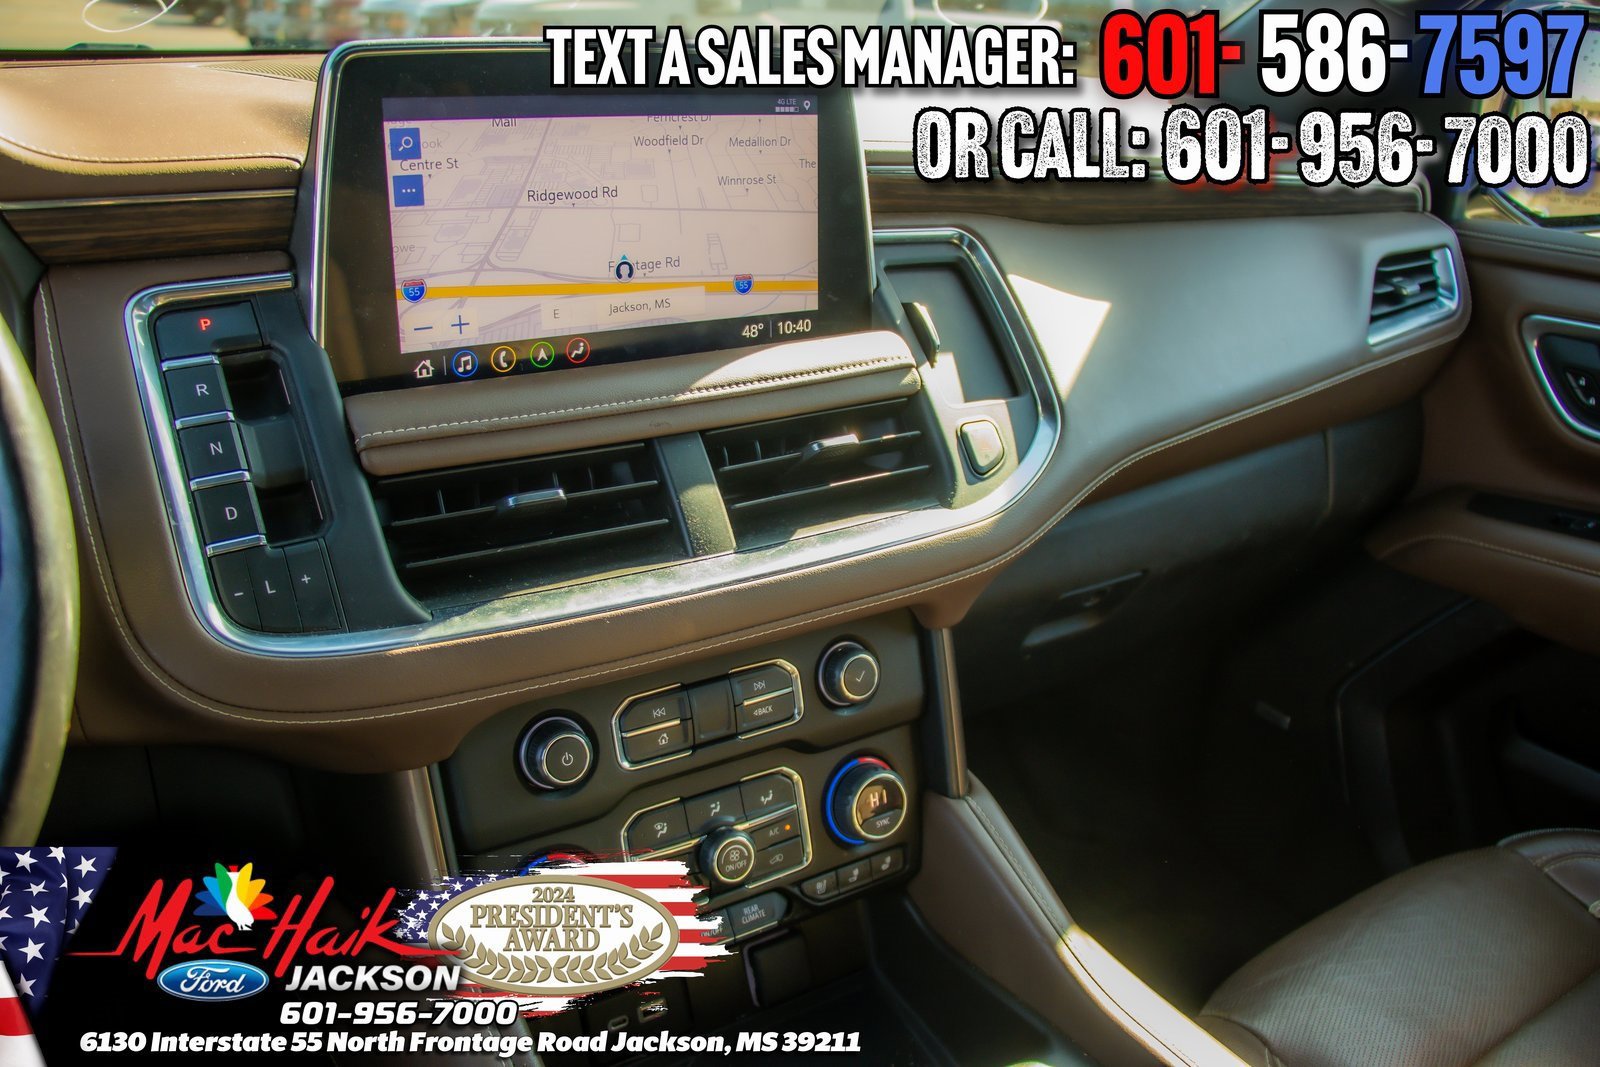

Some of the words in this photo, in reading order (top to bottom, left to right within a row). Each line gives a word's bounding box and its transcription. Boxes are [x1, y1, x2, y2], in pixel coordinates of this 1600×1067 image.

[776, 98, 786, 106] 4G
[491, 118, 517, 128] Mall
[633, 135, 689, 147] Woodfield
[691, 135, 704, 146] Dr
[728, 136, 778, 148] Medallion
[779, 136, 792, 147] Dr
[399, 159, 443, 172] Centre
[446, 157, 460, 170] St
[799, 158, 817, 170] The
[717, 175, 764, 187] Winnrose
[766, 174, 778, 185] St
[527, 186, 599, 204] Ridgewood
[602, 186, 618, 199] Rd
[608, 260, 662, 273] Ftage
[665, 256, 681, 268] Rd
[408, 287, 421, 297] 55
[738, 281, 750, 290] 55
[608, 302, 652, 317] Jackson,
[654, 298, 671, 309] MS
[553, 309, 560, 320] E
[200, 318, 211, 331] P
[777, 319, 812, 335] 10:40
[195, 383, 209, 397] R
[210, 441, 224, 455] N
[225, 506, 238, 521] D
[265, 580, 276, 595] L
[757, 705, 774, 716] BACK
[876, 817, 891, 829] SYNC
[769, 826, 780, 837] A/C
[725, 859, 747, 873] ON/OFF
[743, 903, 759, 915] REAR
[741, 908, 767, 925] CLIMATE
